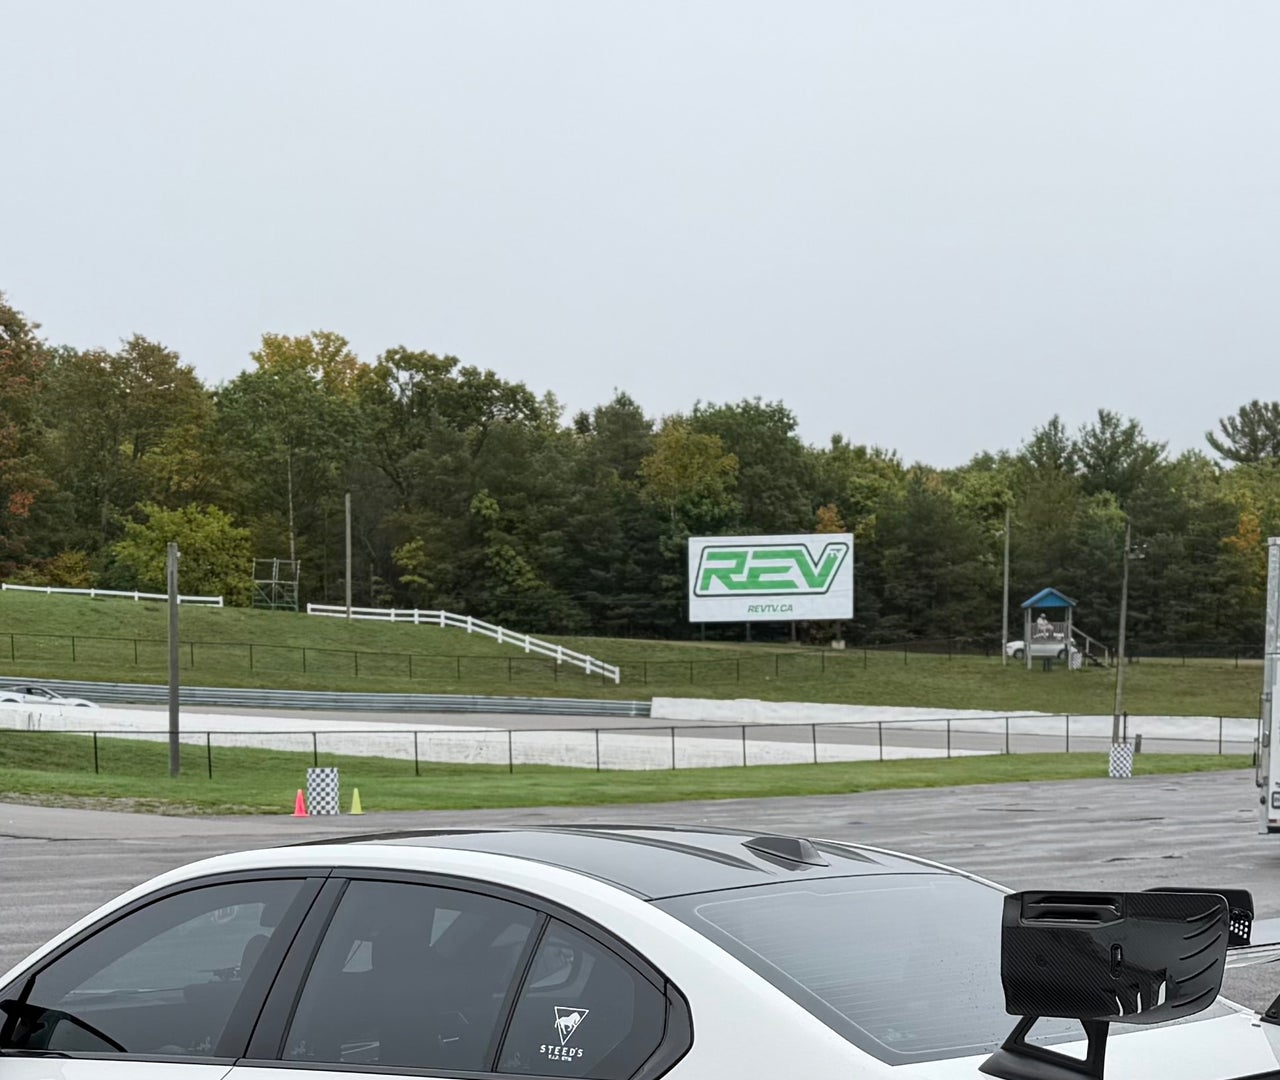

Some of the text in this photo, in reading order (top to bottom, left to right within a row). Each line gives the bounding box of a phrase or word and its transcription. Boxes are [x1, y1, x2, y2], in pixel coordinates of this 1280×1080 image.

[699, 549, 840, 591] REV
[747, 604, 794, 613] REVTV.CA
[539, 1044, 584, 1058] STEED'S
